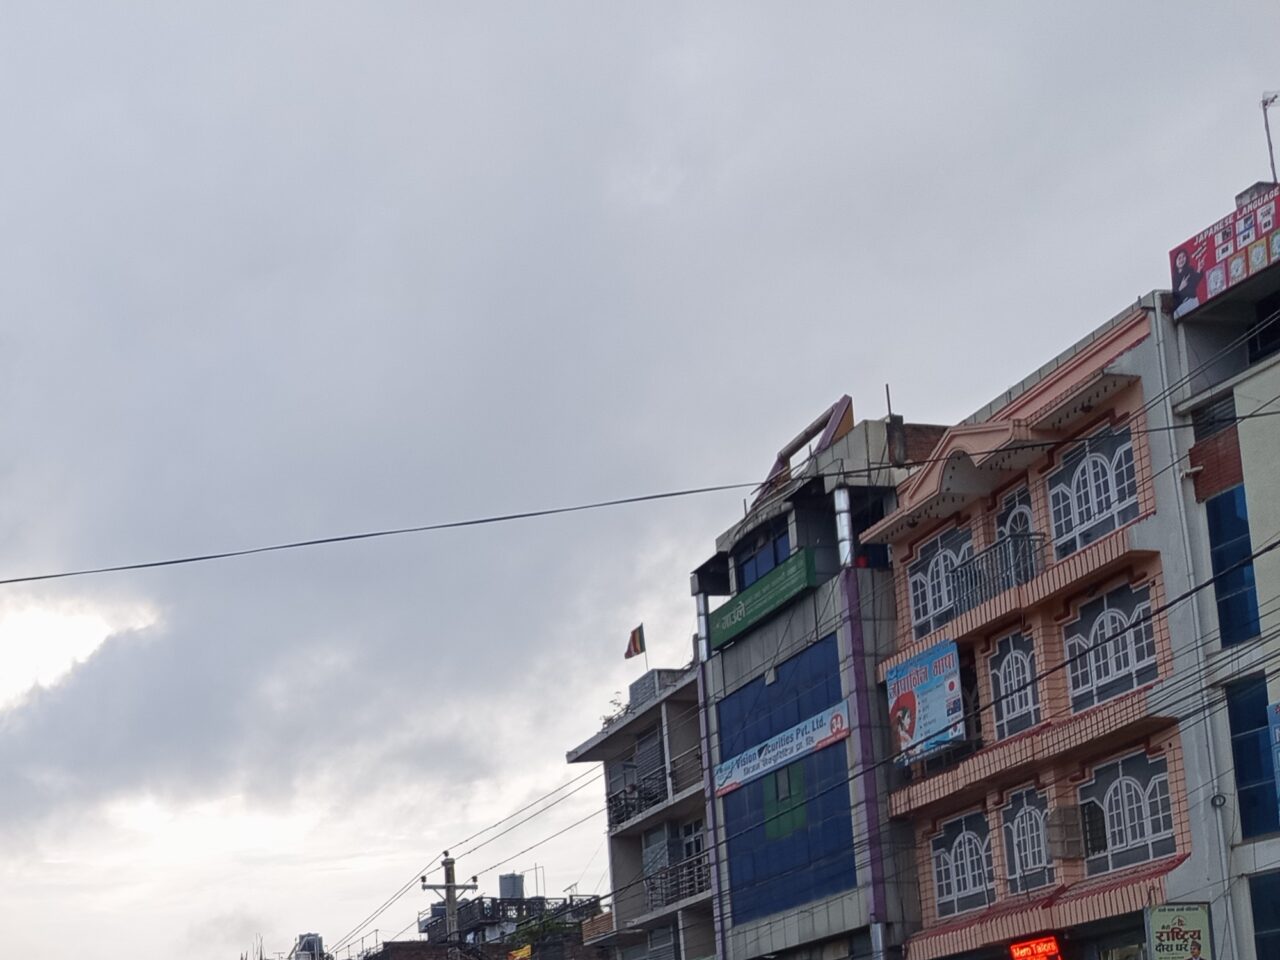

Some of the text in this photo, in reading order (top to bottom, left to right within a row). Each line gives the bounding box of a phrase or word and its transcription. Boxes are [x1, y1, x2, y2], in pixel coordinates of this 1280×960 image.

[1194, 186, 1280, 246] JAPANESE LANGUAGE
[735, 751, 757, 769] Vision
[795, 726, 810, 740] Pvt.
[812, 717, 827, 733] Ltd.
[1155, 927, 1202, 943] राष्ट्रिय
[1176, 943, 1189, 952] घर
